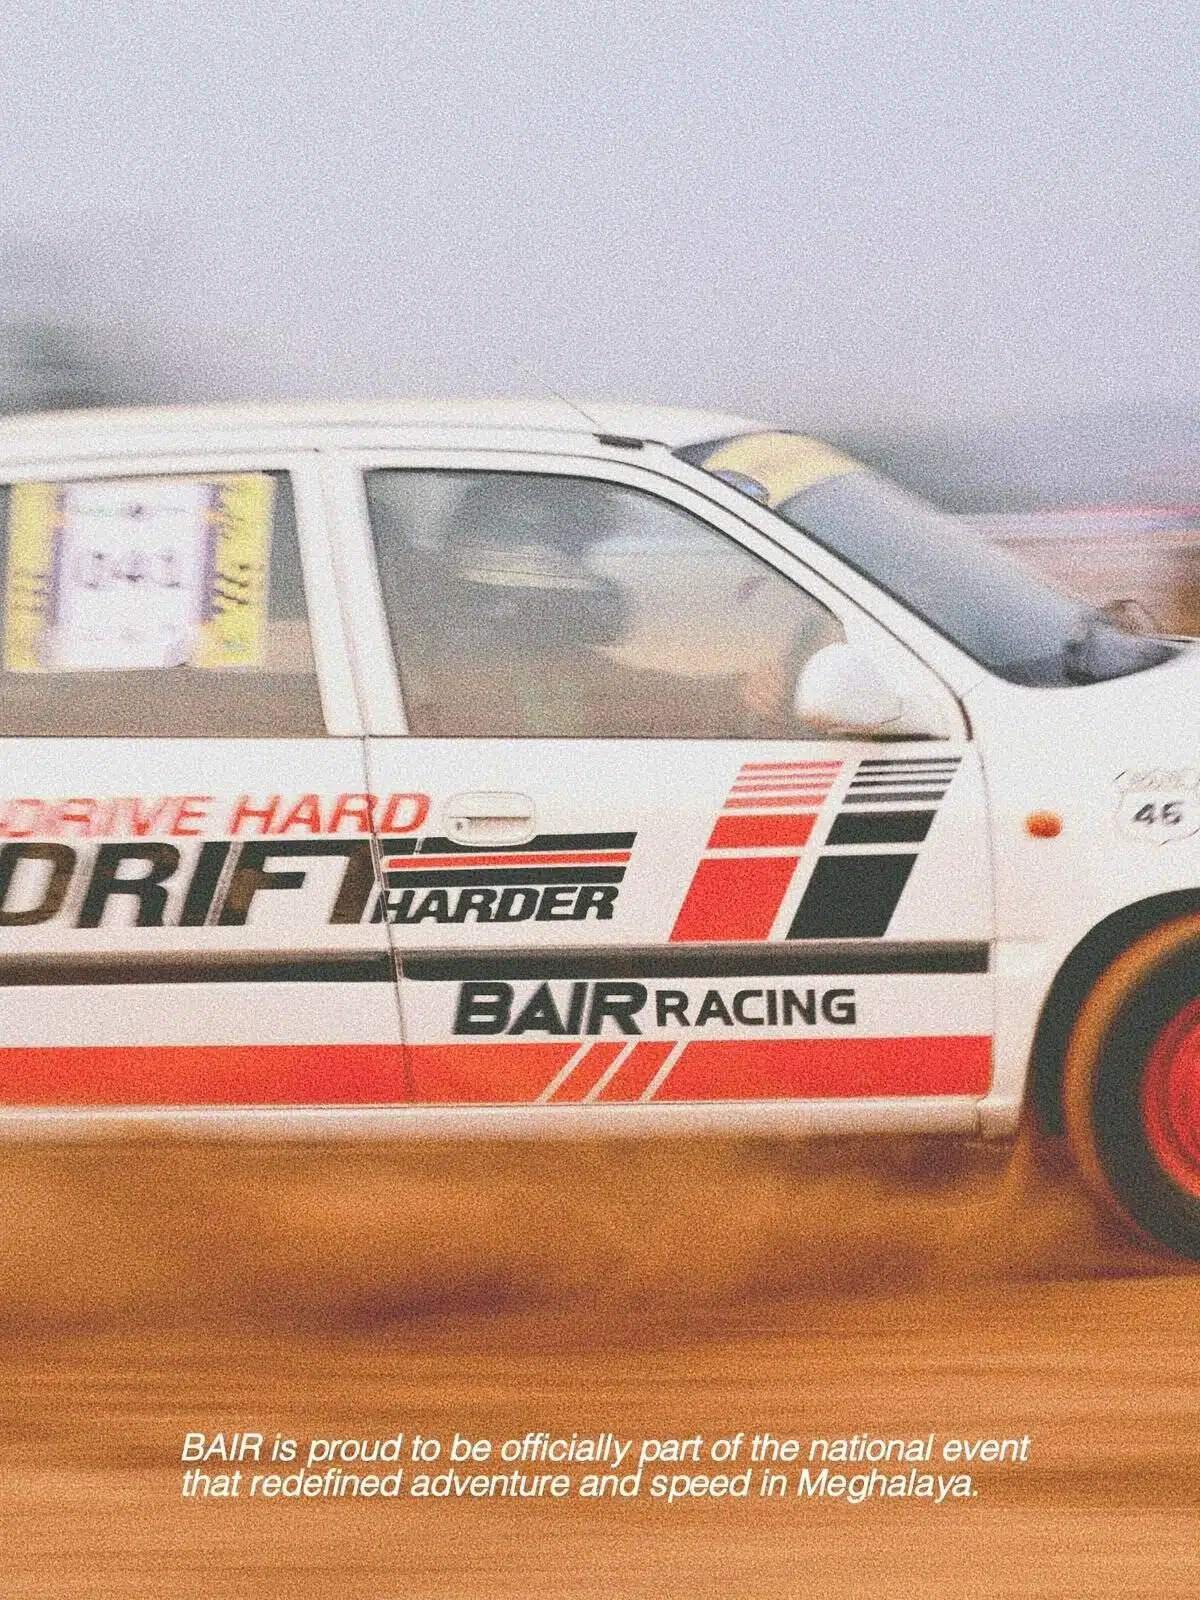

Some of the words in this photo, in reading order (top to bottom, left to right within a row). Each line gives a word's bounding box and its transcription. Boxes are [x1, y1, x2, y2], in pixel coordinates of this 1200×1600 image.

[0, 796, 213, 838] DRIVE
[228, 793, 431, 836] HARD
[0, 837, 412, 928] DRIFT
[370, 886, 619, 924] HARDER
[453, 981, 648, 1036] BAIR
[656, 988, 857, 1027] RACING
